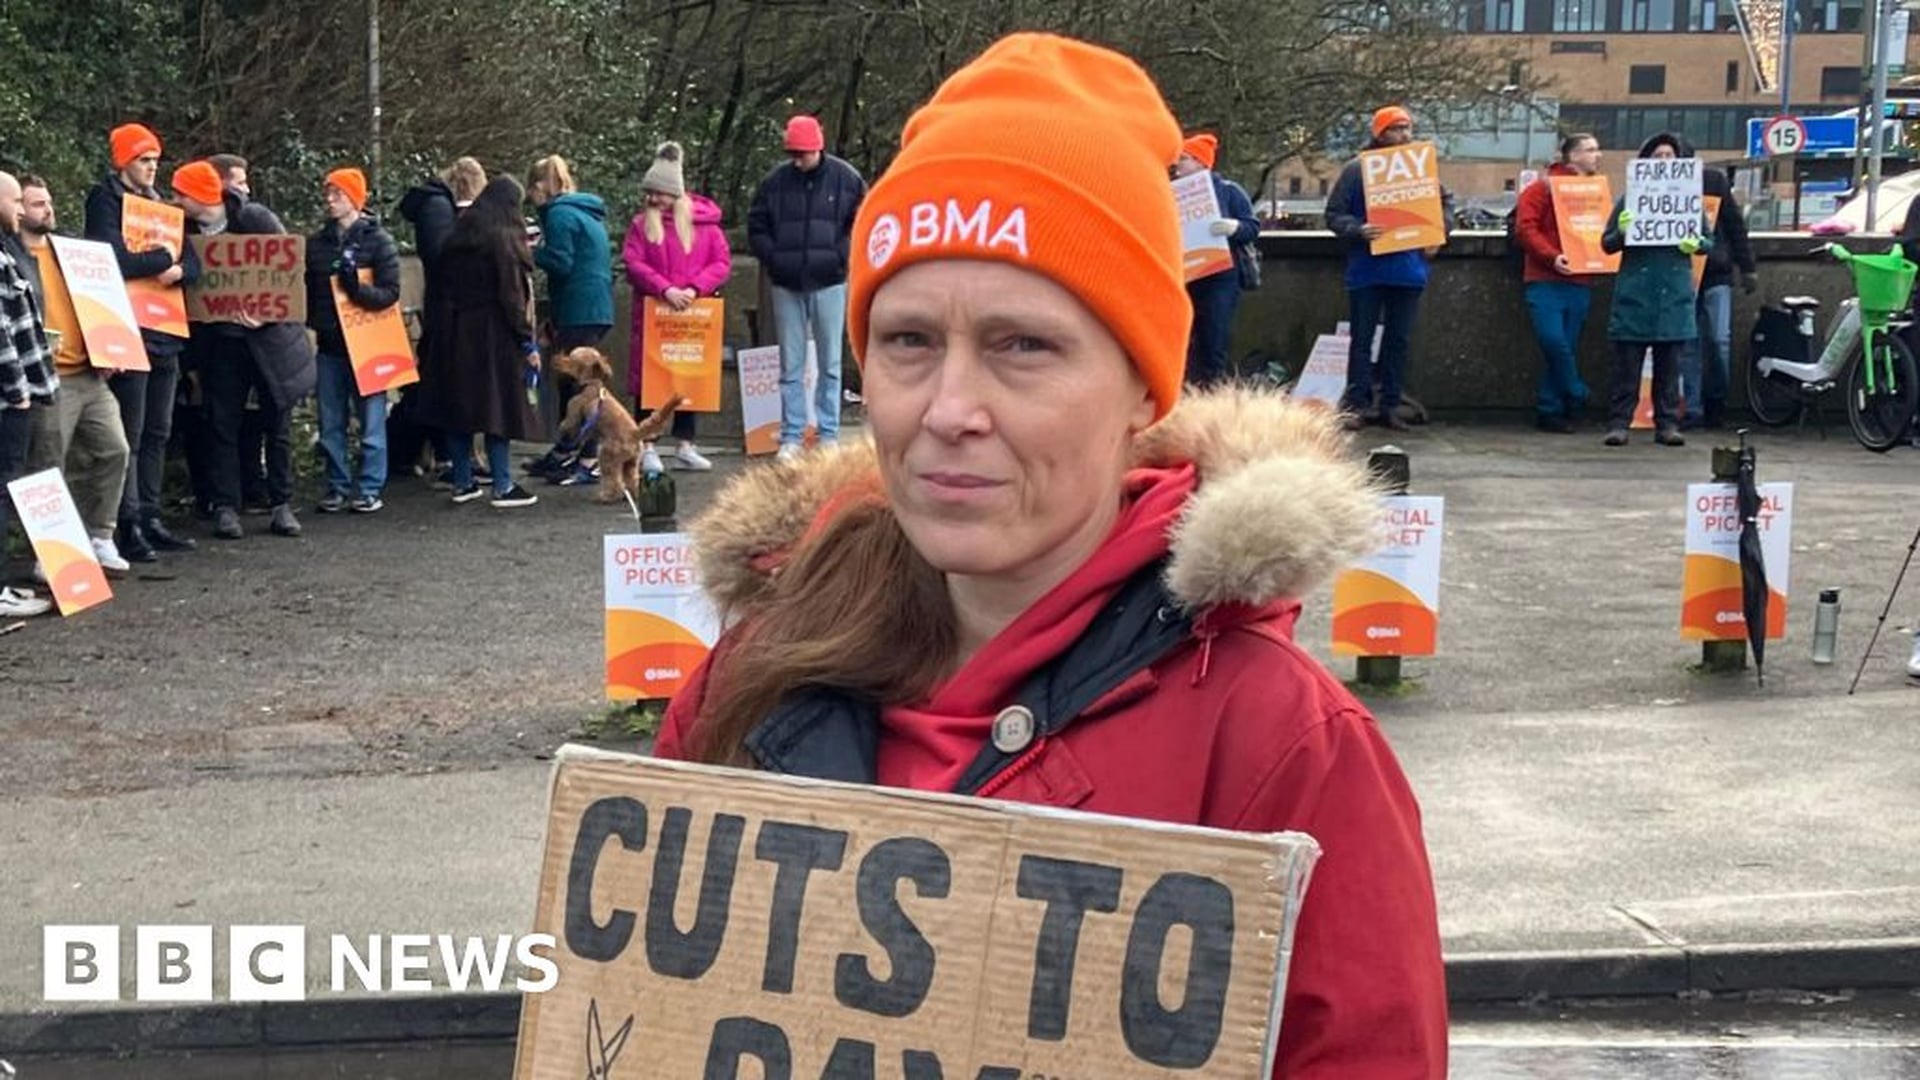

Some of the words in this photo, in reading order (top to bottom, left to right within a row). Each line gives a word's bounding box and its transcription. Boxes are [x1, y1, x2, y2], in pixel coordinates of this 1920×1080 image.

[1773, 128, 1796, 147] 15
[1367, 146, 1430, 184] PAY
[1635, 162, 1669, 180] FAIR
[1671, 161, 1696, 179] PAY
[1369, 186, 1437, 205] DOCTORS
[1638, 194, 1701, 214] PUBLIC
[909, 199, 1029, 257] BMA
[1632, 219, 1700, 241] SECTOR
[204, 238, 297, 271] CLAPS
[202, 293, 290, 319] WAGES
[565, 796, 952, 1018] CUTS
[1016, 854, 1235, 1070] TO
